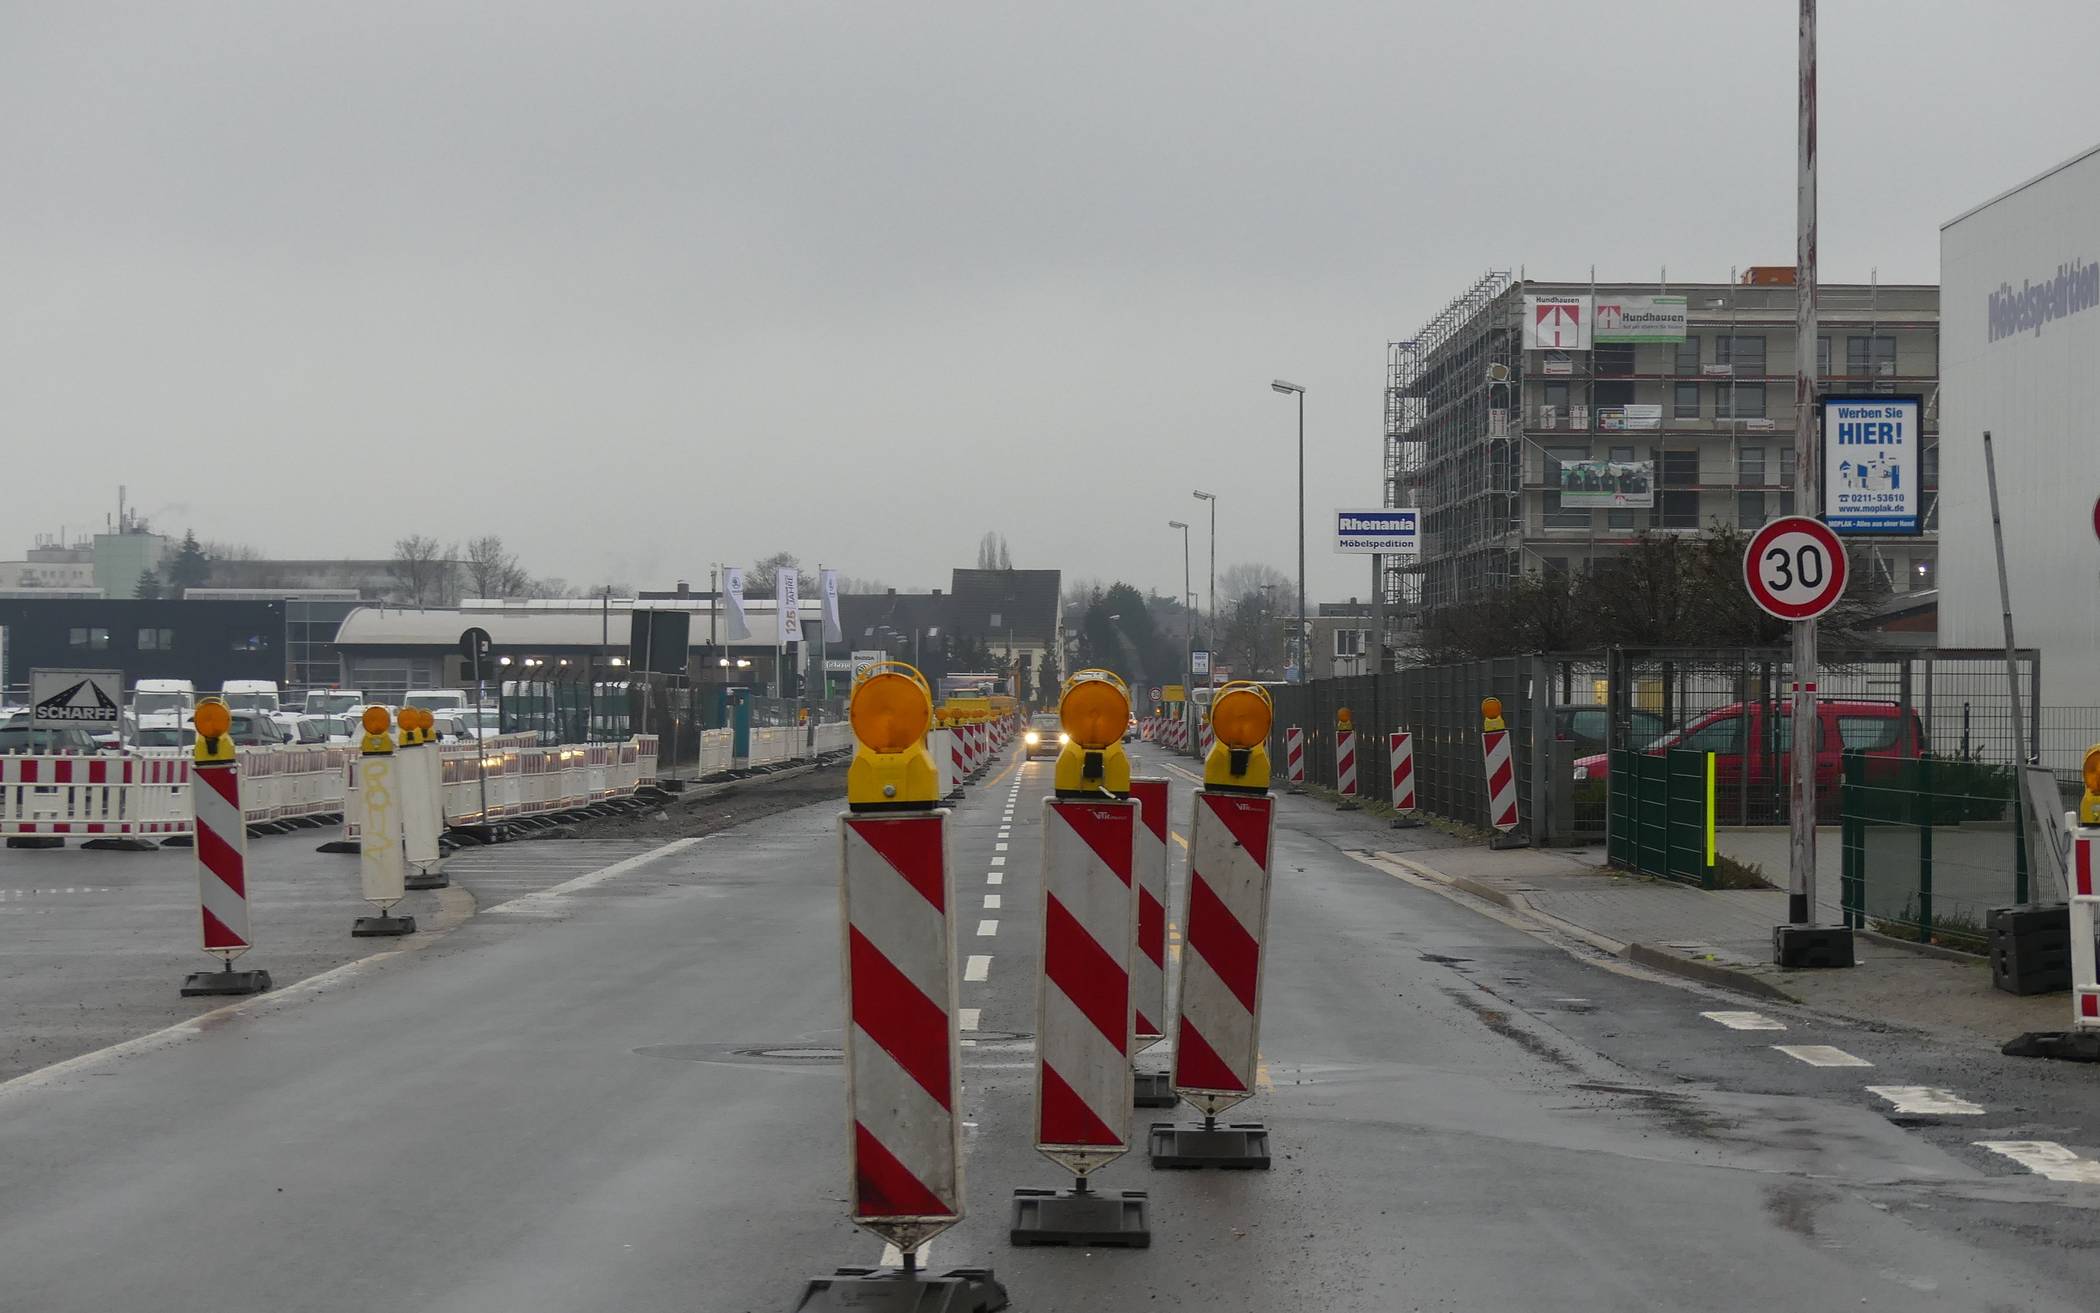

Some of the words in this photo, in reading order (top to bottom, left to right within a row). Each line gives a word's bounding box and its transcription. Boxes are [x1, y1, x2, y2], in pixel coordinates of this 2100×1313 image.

[1988, 257, 2099, 343] Möbelspedition
[1622, 312, 1684, 322] Hundhausen
[1838, 407, 1882, 419] Werben
[1884, 407, 1903, 419] Sie
[1838, 422, 1902, 445] HIER!
[1851, 494, 1904, 502] 0211-53610
[1838, 504, 1904, 513] www.moplak.de
[1340, 518, 1414, 531] Rhenania
[1340, 539, 1414, 549] Möbelspedition
[1765, 544, 1823, 591] 30
[785, 610, 797, 635] 125
[36, 706, 116, 720] SCHARFF
